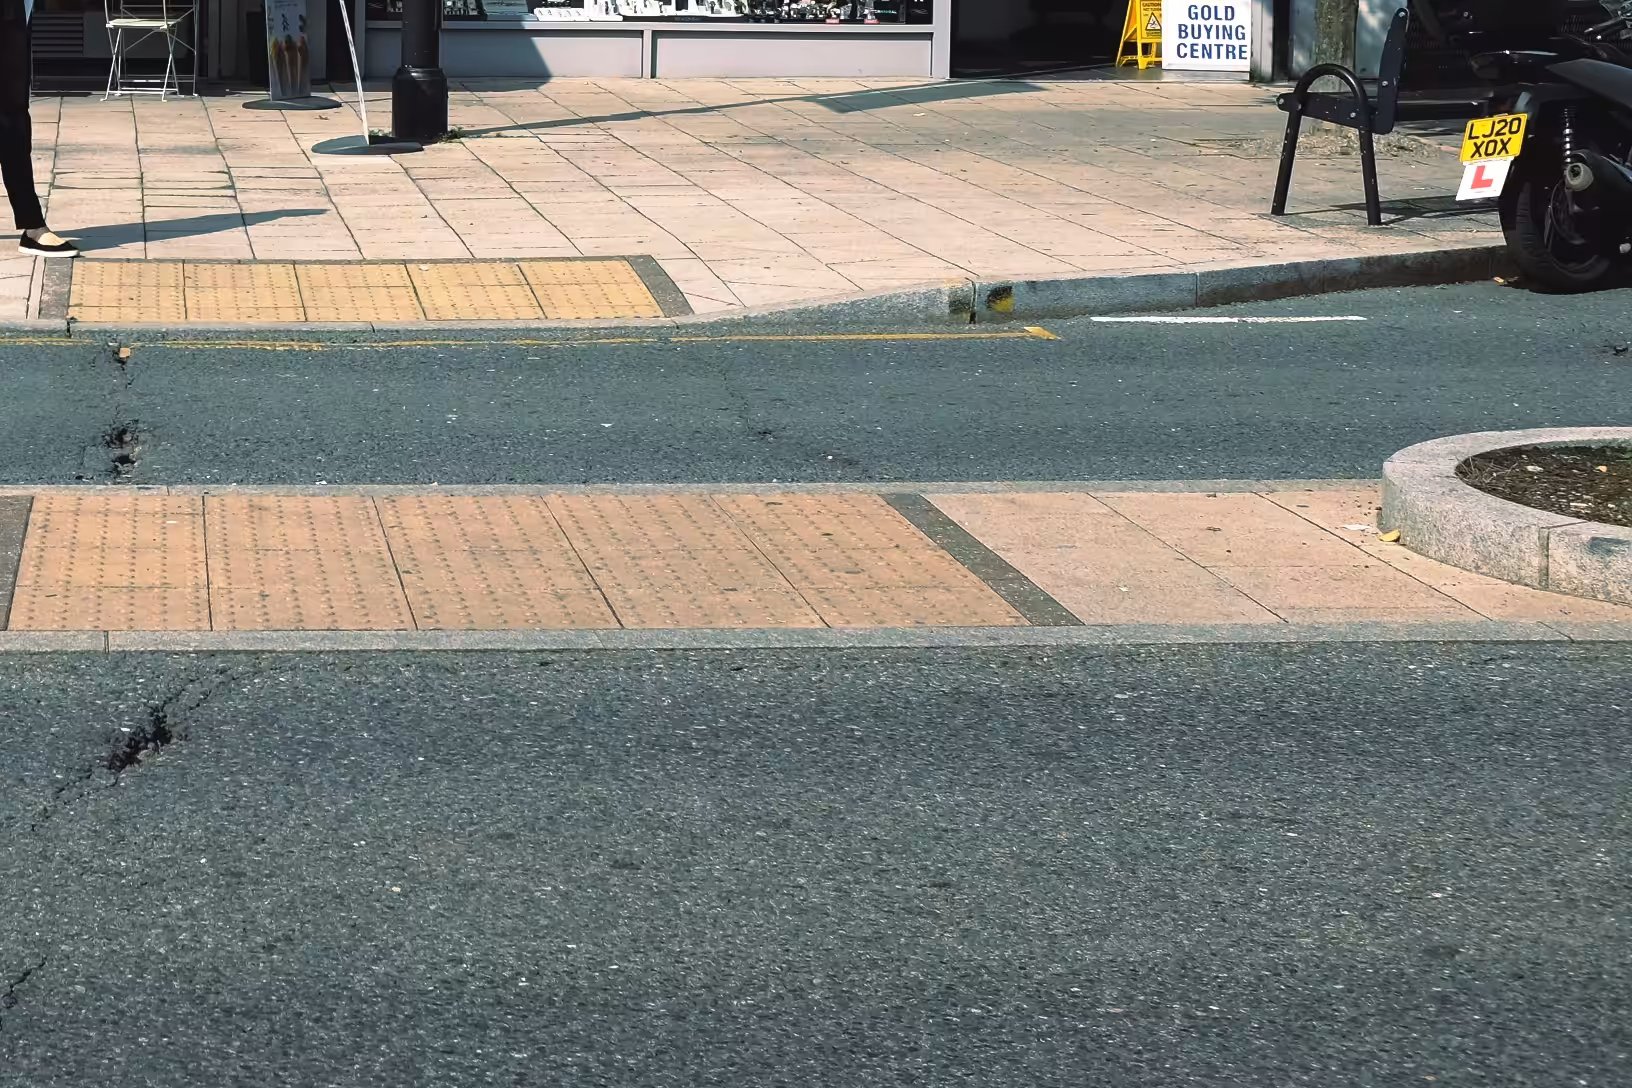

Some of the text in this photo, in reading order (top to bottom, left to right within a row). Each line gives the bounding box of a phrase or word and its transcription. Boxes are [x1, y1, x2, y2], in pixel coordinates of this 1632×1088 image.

[1187, 4, 1236, 21] GOLD
[1177, 23, 1246, 41] BUYING
[1176, 43, 1248, 60] CENTRE
[1467, 116, 1523, 141] LJ20
[1469, 137, 1513, 159] XOX
[1470, 165, 1494, 189] L
